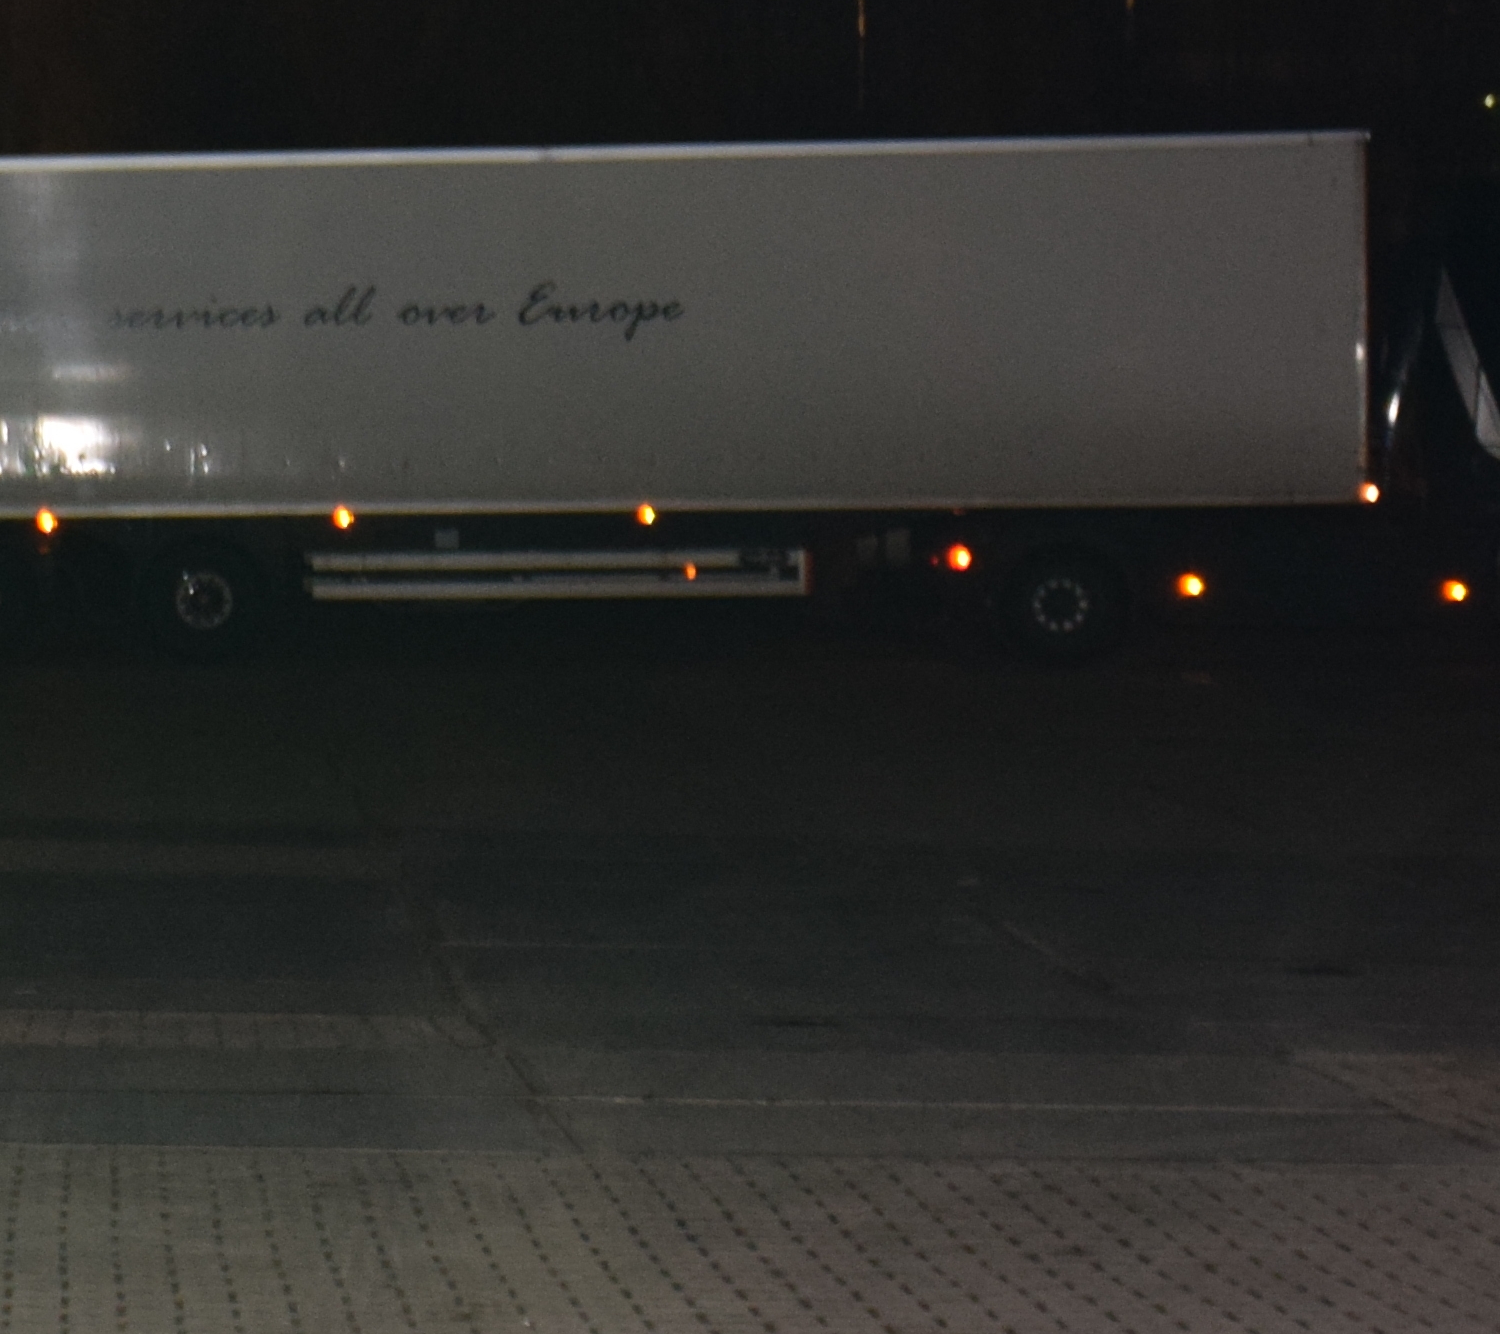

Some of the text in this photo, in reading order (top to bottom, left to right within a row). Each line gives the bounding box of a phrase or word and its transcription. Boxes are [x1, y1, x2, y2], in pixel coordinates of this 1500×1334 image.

[107, 296, 281, 330] services
[303, 284, 377, 328] all
[396, 300, 496, 327] over
[517, 279, 686, 343] Europe
